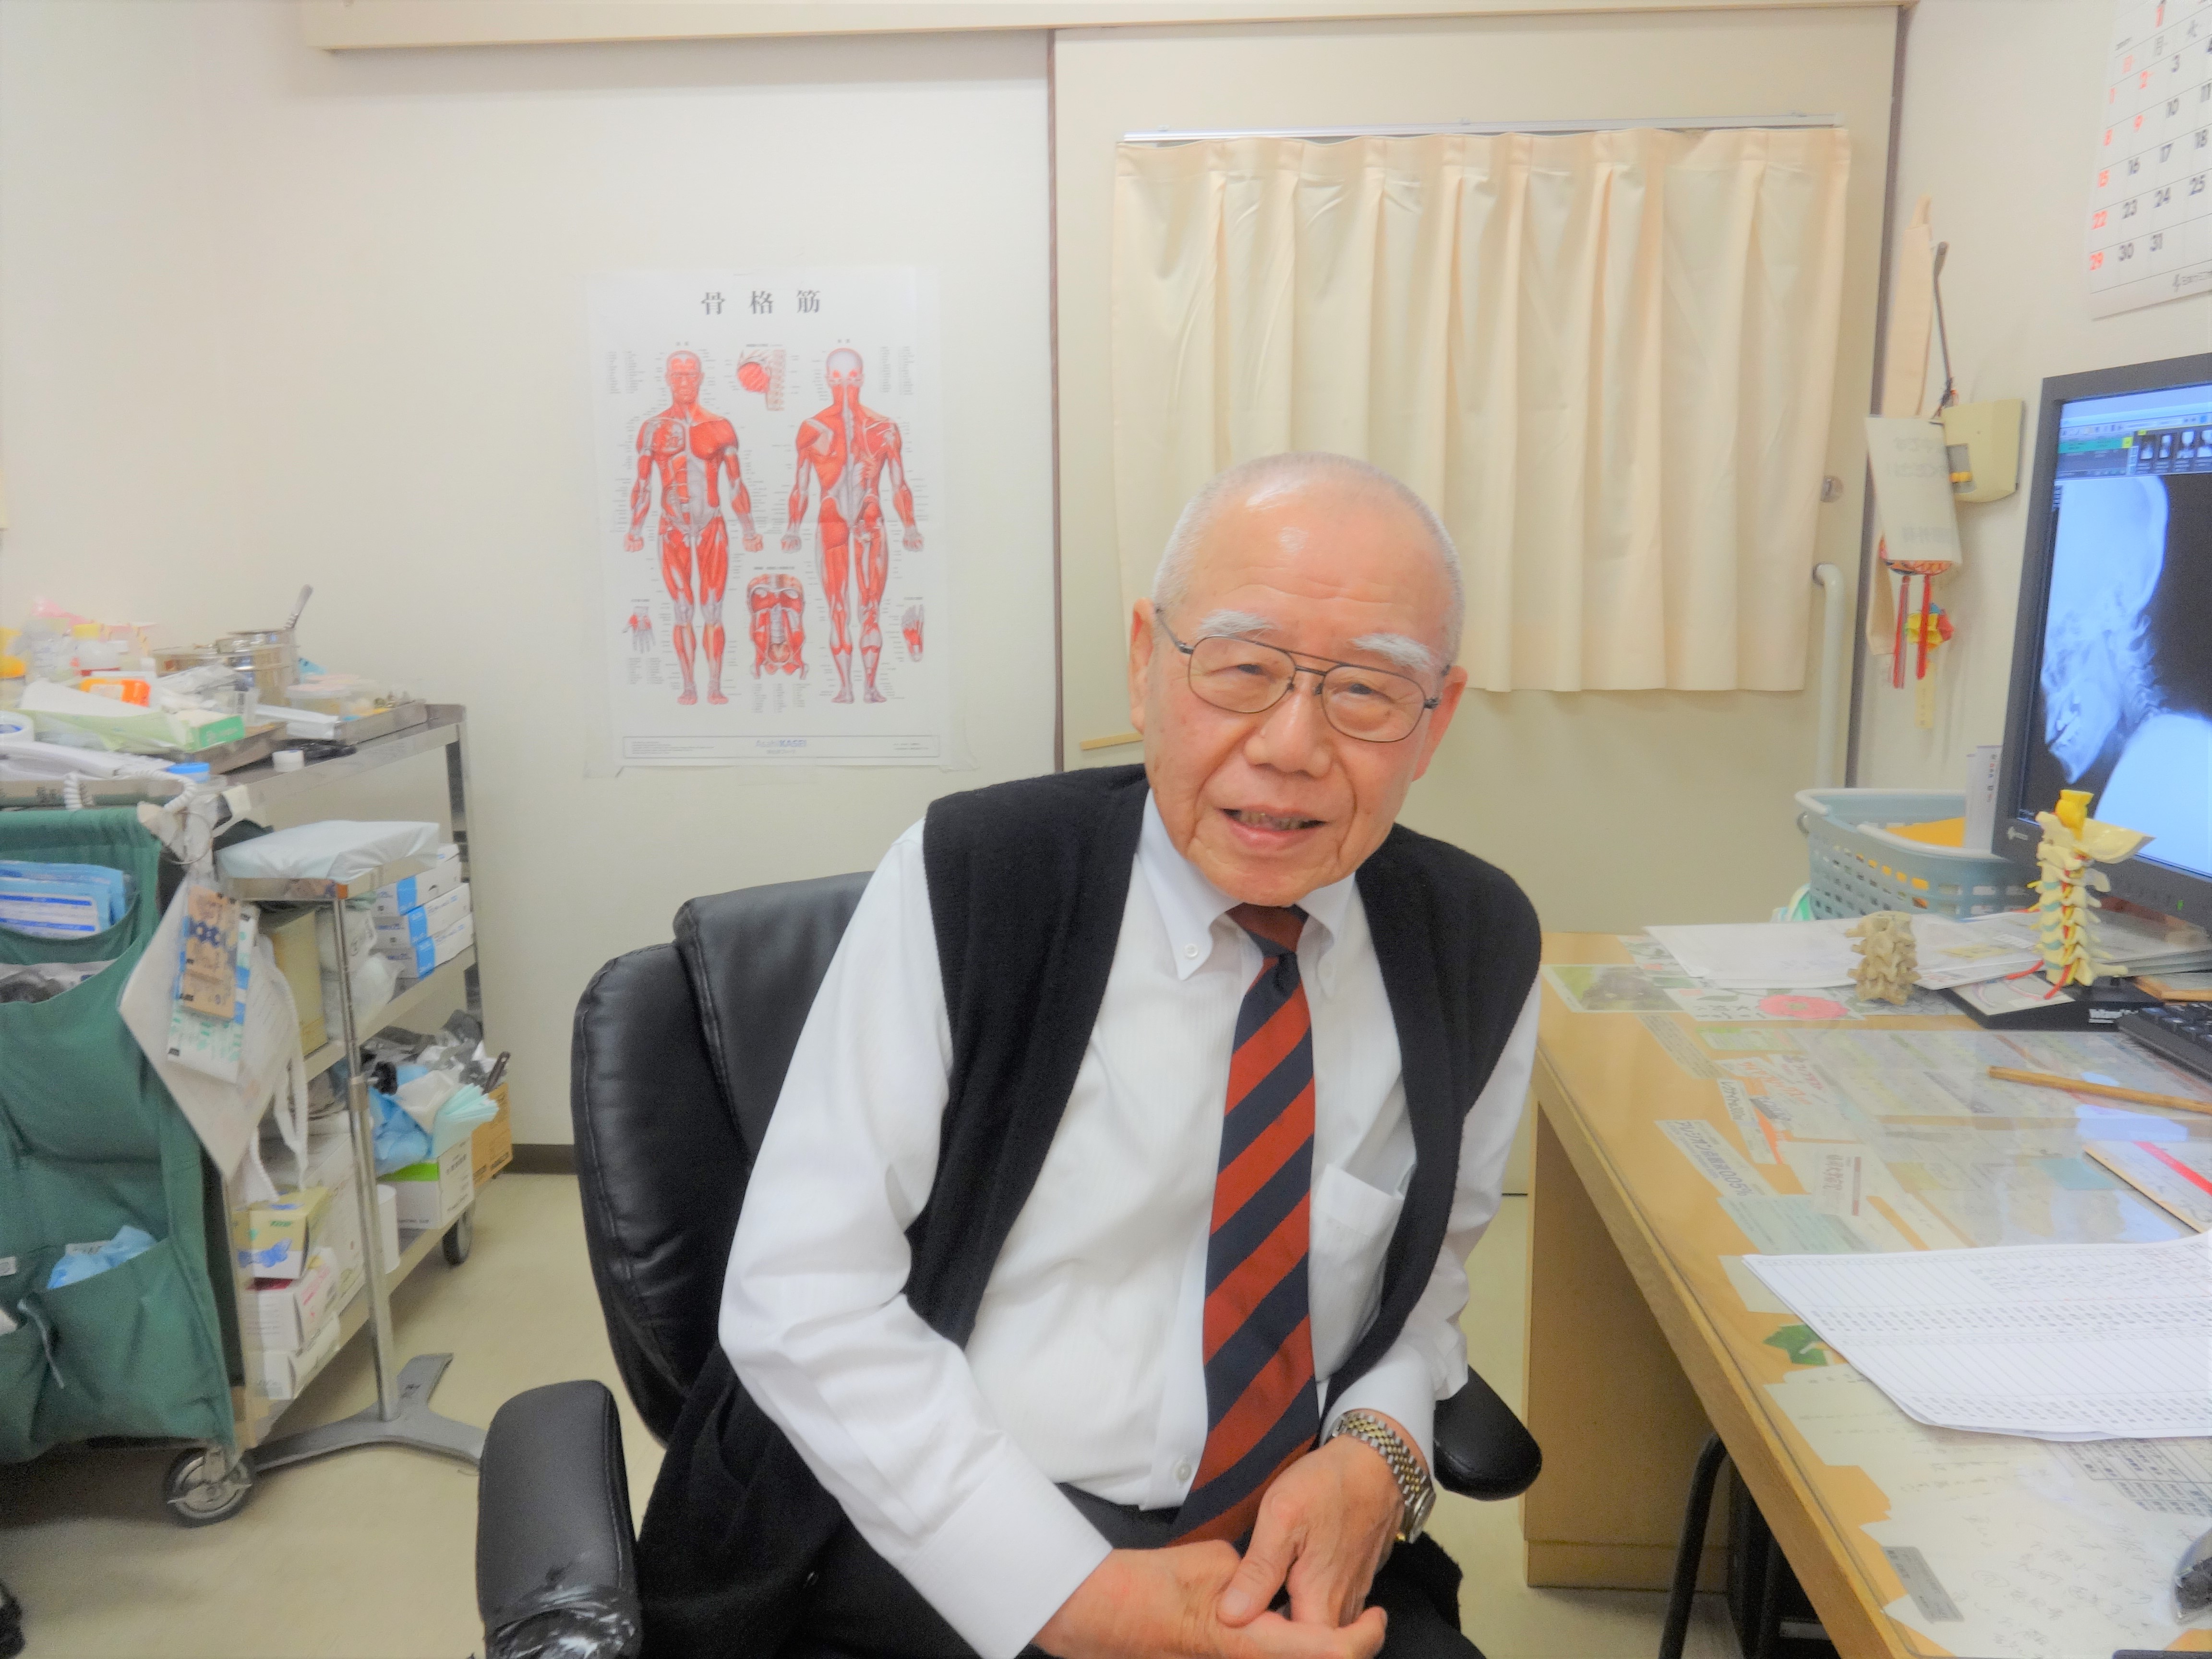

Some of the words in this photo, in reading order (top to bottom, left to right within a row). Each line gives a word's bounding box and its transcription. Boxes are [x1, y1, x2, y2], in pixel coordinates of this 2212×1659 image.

[2171, 54, 2180, 72] 3
[2166, 97, 2179, 119] 10
[2098, 169, 2110, 188] 15
[2159, 142, 2174, 164] 17
[2194, 129, 2209, 150] 18
[2091, 210, 2108, 230] 22
[2121, 199, 2138, 220] 23
[2152, 187, 2171, 208] 24
[2188, 174, 2206, 196] 25
[2089, 251, 2104, 271] 29
[2118, 242, 2134, 262] 30
[2149, 232, 2163, 252] 31
[701, 289, 820, 315] 骨格筋
